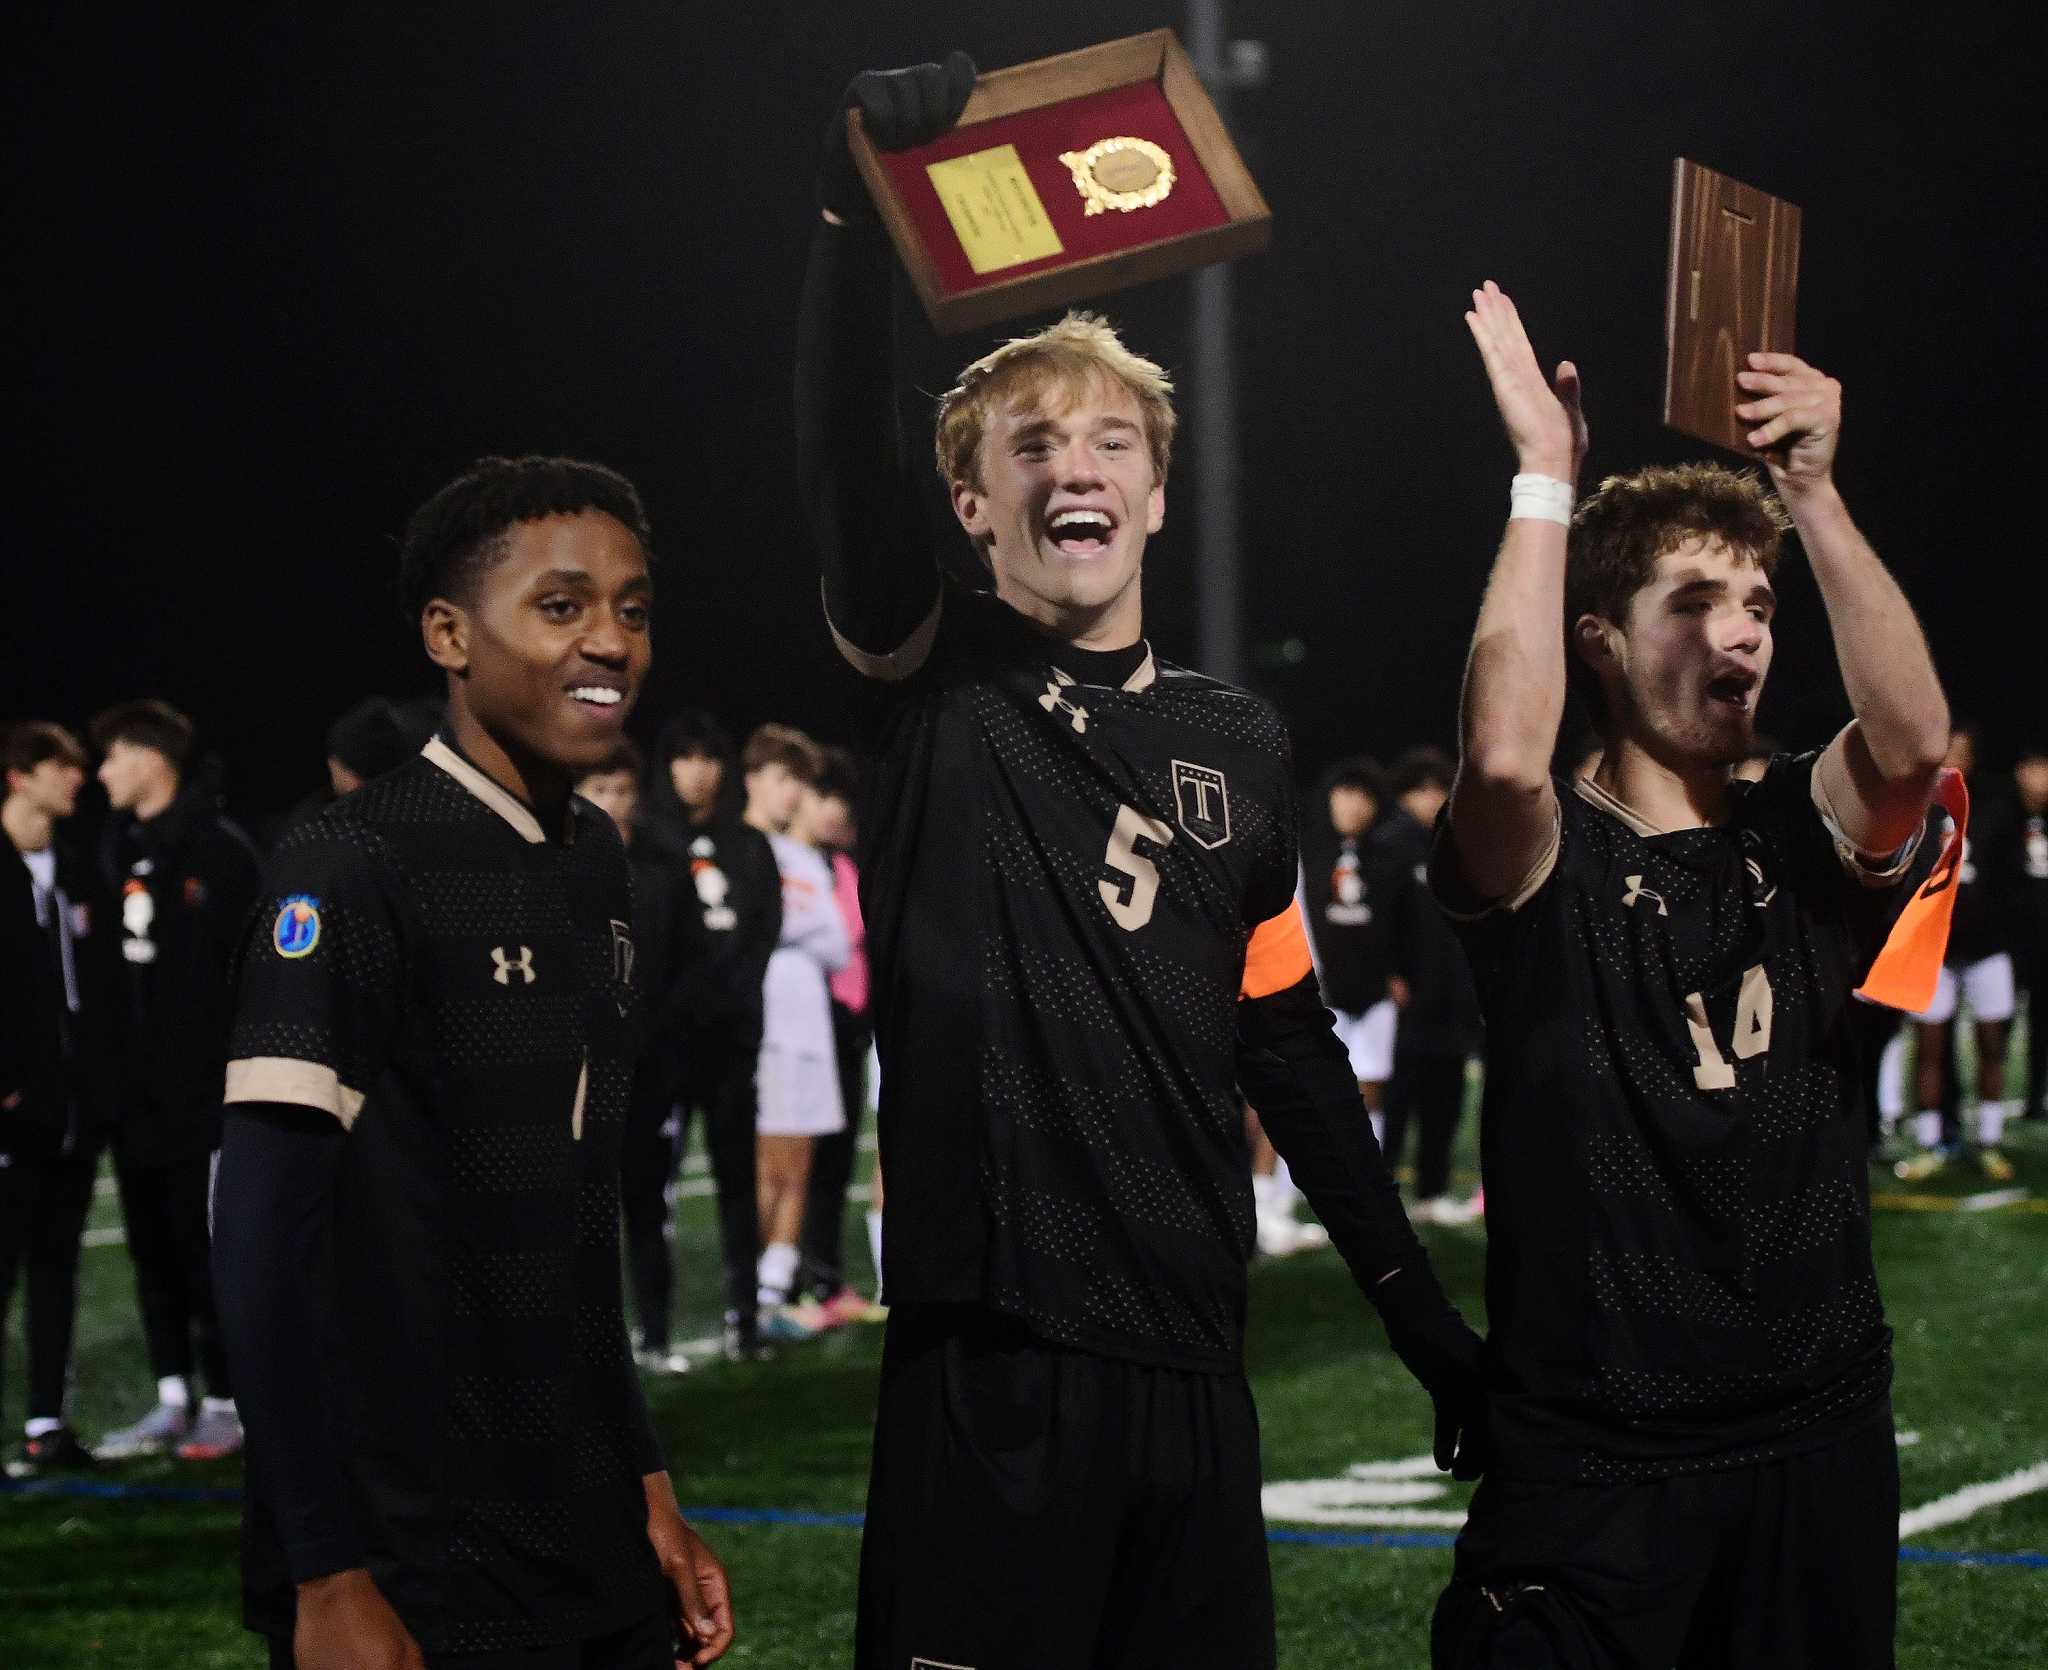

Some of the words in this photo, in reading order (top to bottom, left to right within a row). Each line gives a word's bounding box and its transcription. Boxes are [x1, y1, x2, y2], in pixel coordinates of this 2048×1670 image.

[1180, 775, 1220, 823] T
[1097, 803, 1175, 932] 5
[1685, 962, 1774, 1090] 14
